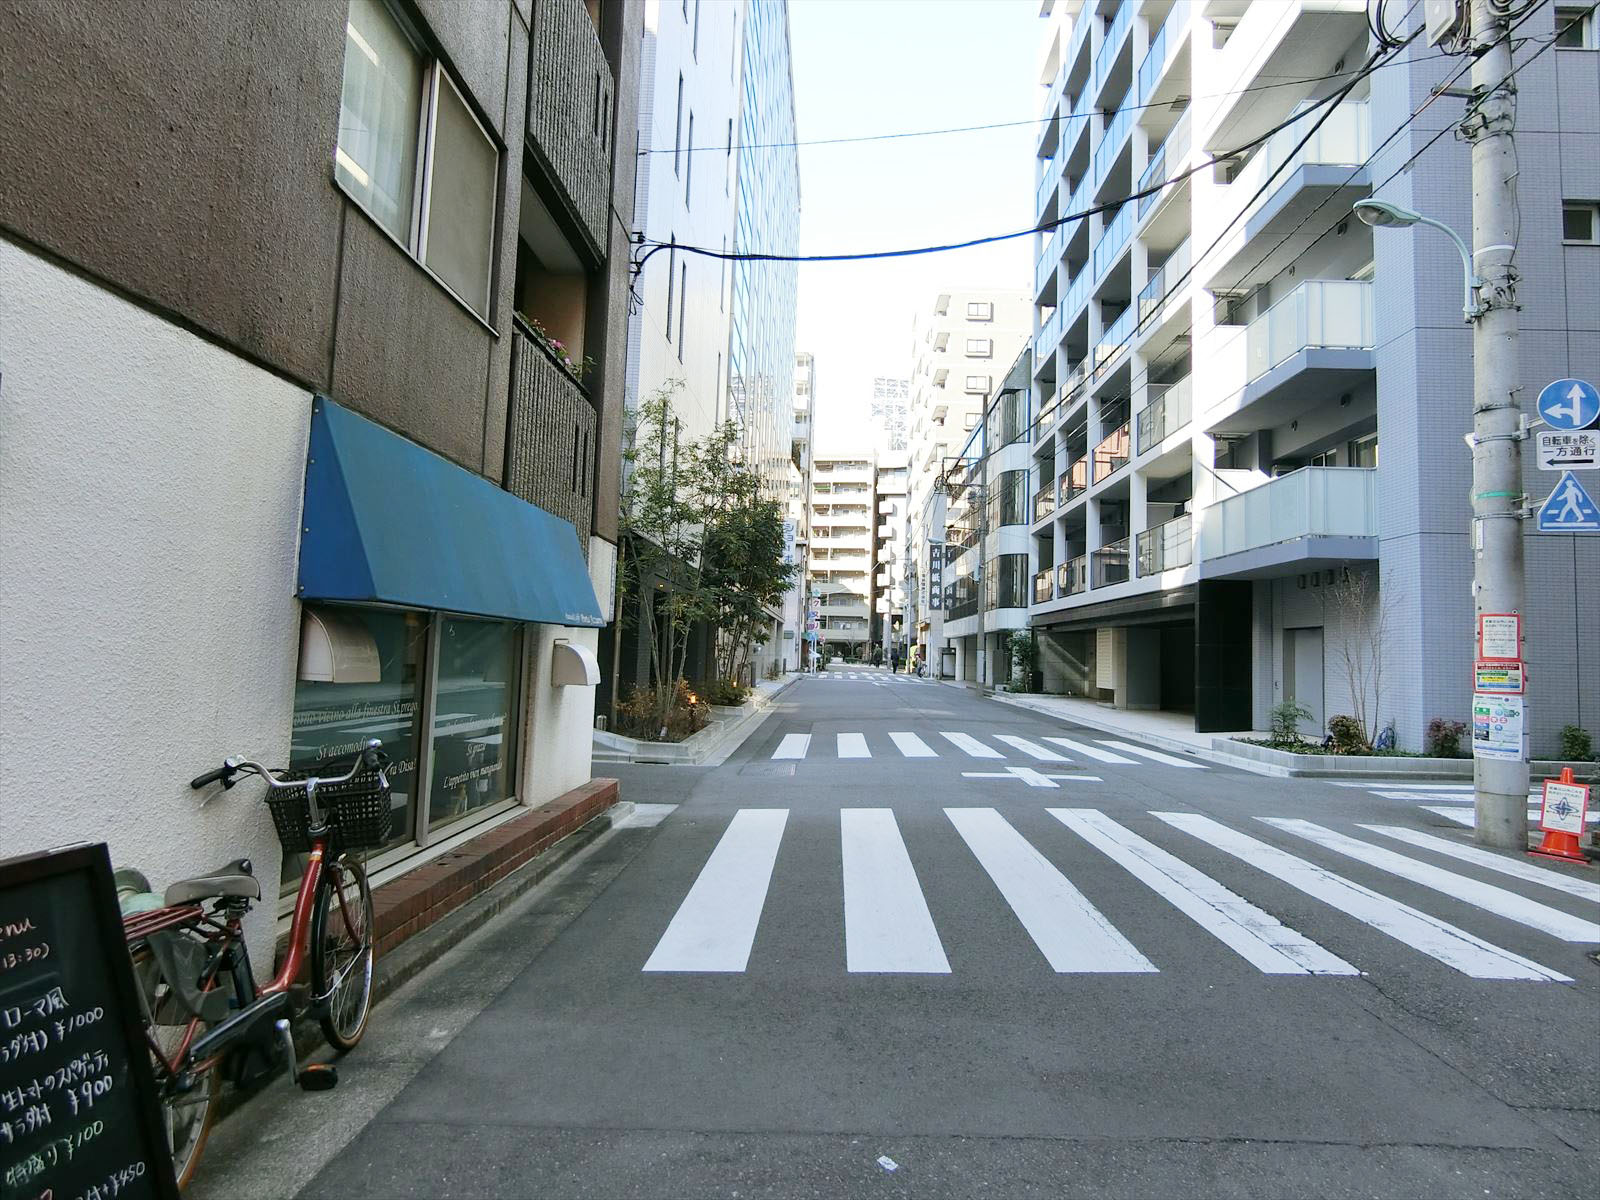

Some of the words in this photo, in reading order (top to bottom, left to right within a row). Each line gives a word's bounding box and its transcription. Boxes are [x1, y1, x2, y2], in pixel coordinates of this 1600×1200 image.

[1542, 435, 1596, 446] 自転車を除く
[1543, 446, 1596, 457] 一方通行
[4, 986, 70, 1028] ローマ風
[55, 1007, 104, 1041] ¥1000
[67, 1075, 113, 1116] ¥900
[64, 1120, 104, 1161] ¥100
